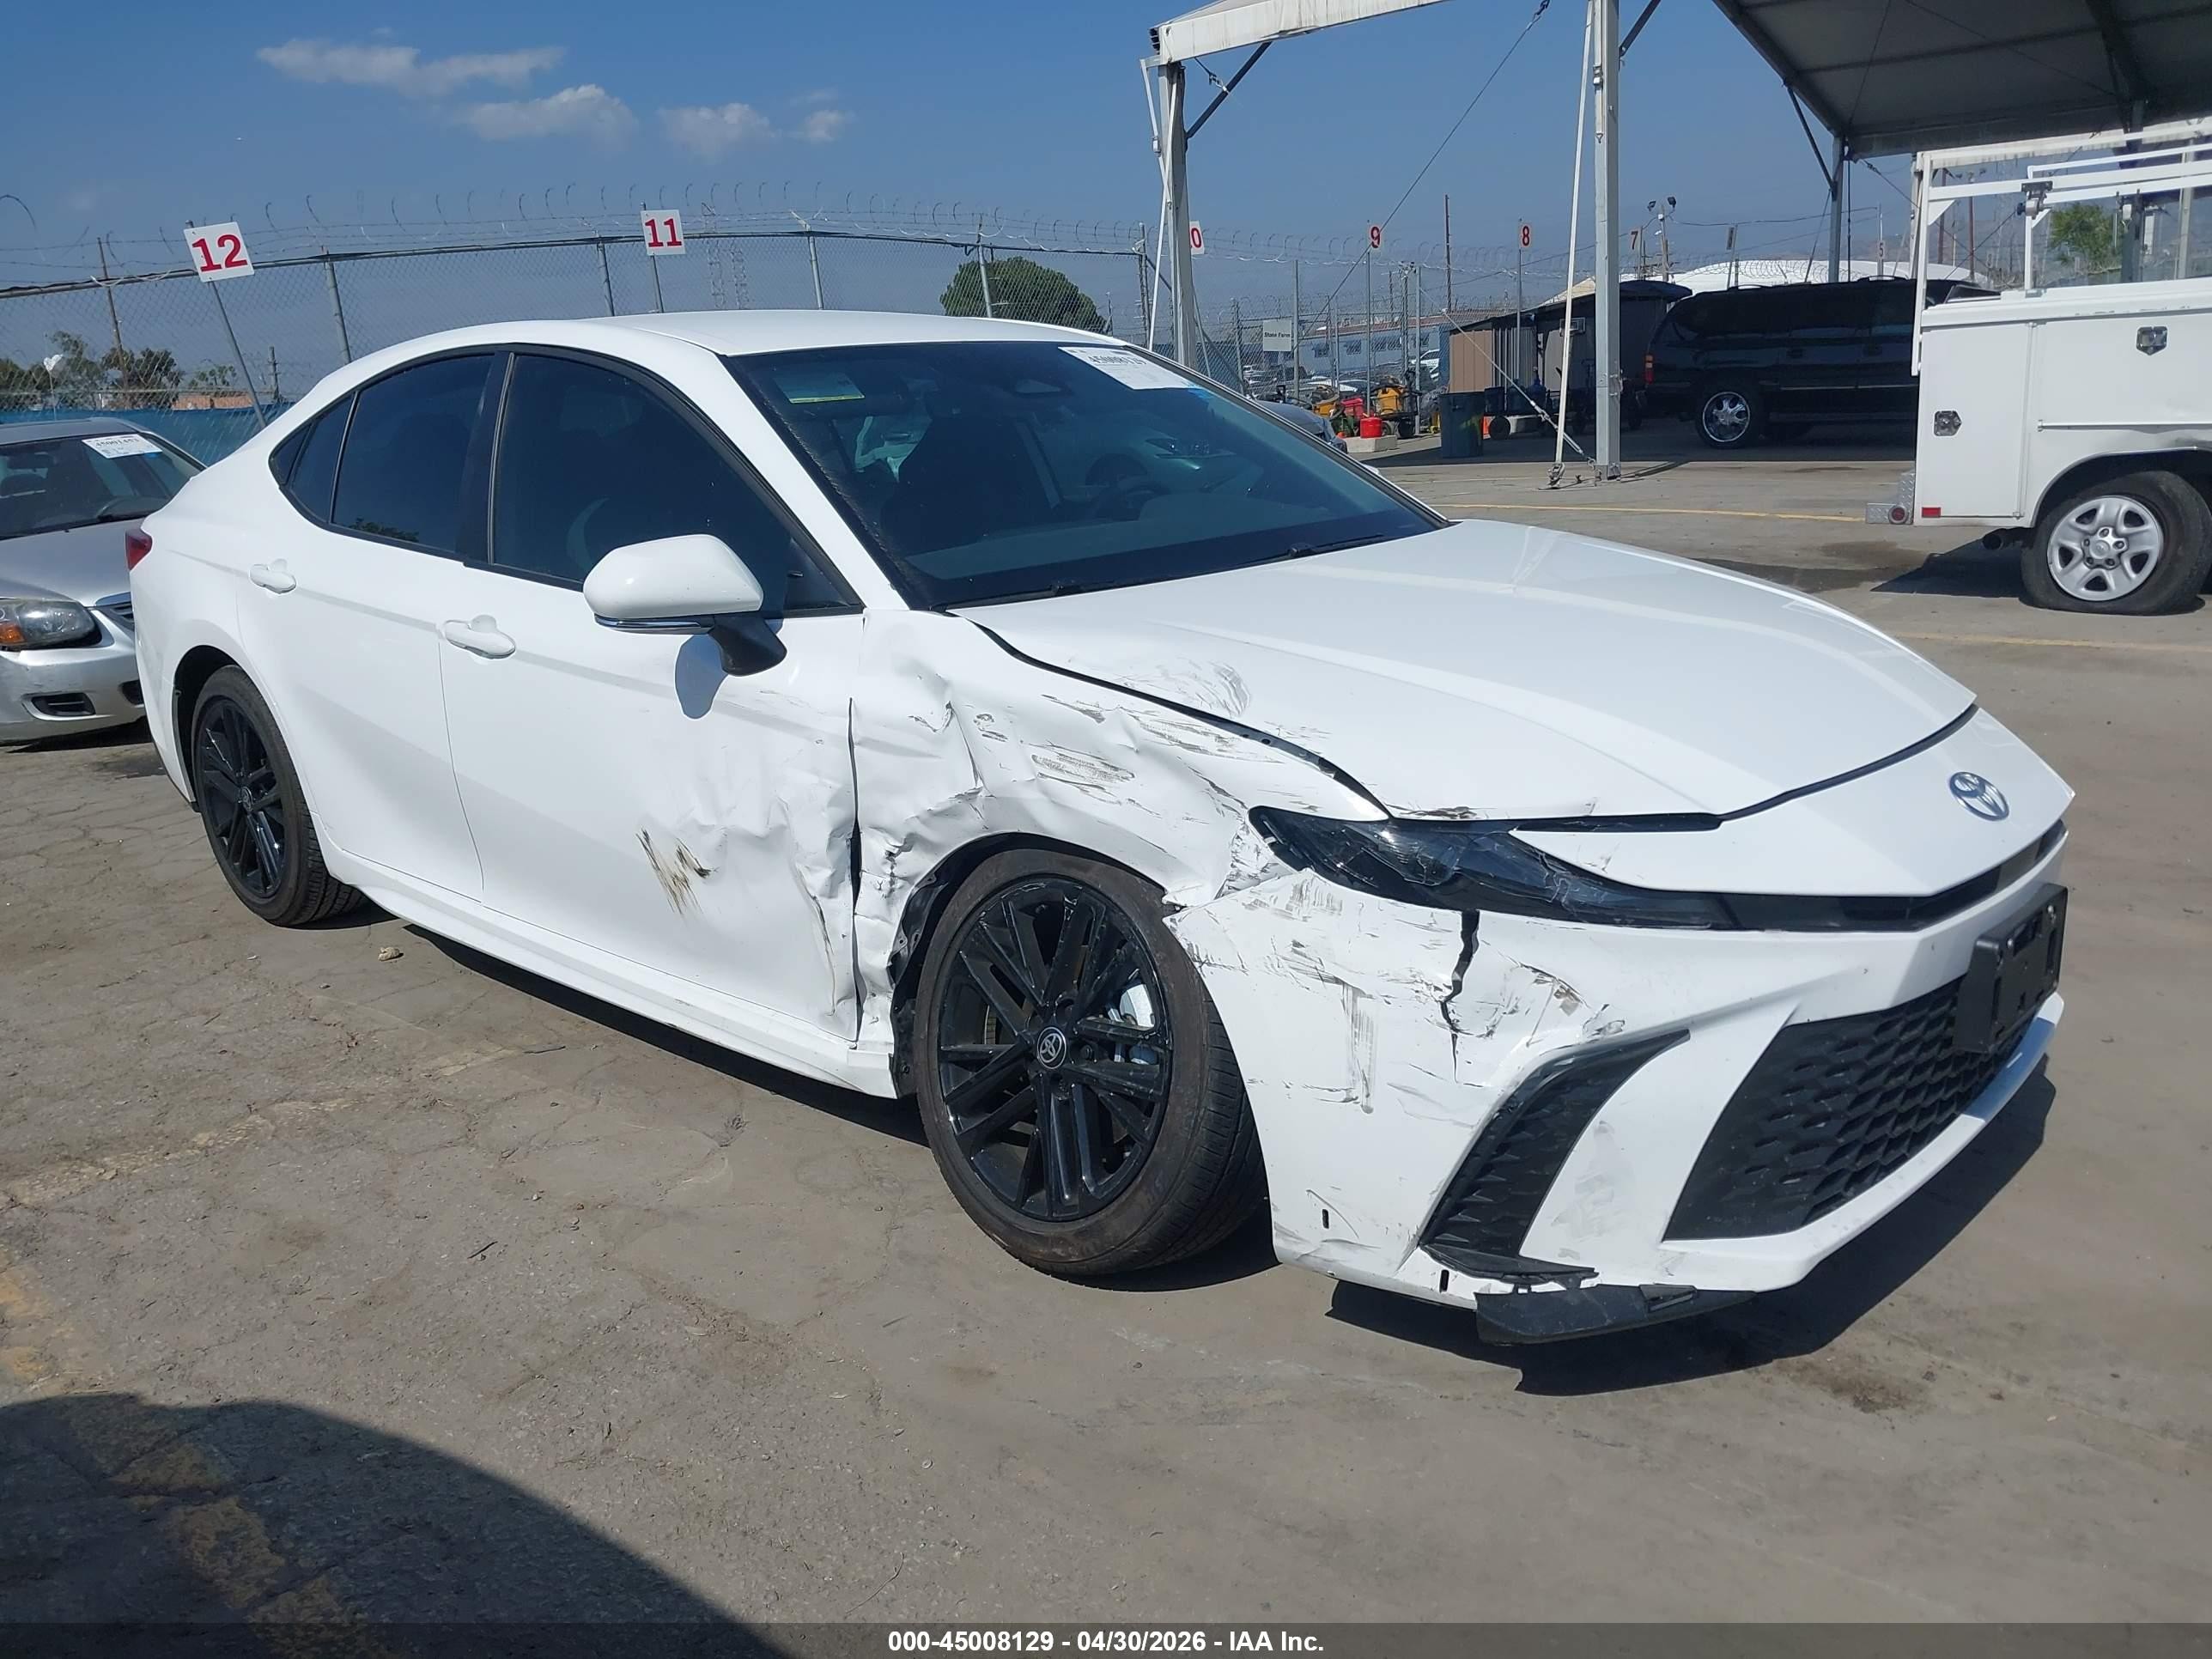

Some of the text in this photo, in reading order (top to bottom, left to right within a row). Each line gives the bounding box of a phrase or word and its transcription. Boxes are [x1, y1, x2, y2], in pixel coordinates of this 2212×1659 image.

[645, 218, 682, 247] 11
[1190, 227, 1202, 248] 0
[1370, 226, 1381, 249] 9
[1522, 225, 1530, 246] 8
[1631, 230, 1638, 250] 7
[191, 234, 248, 272] 12
